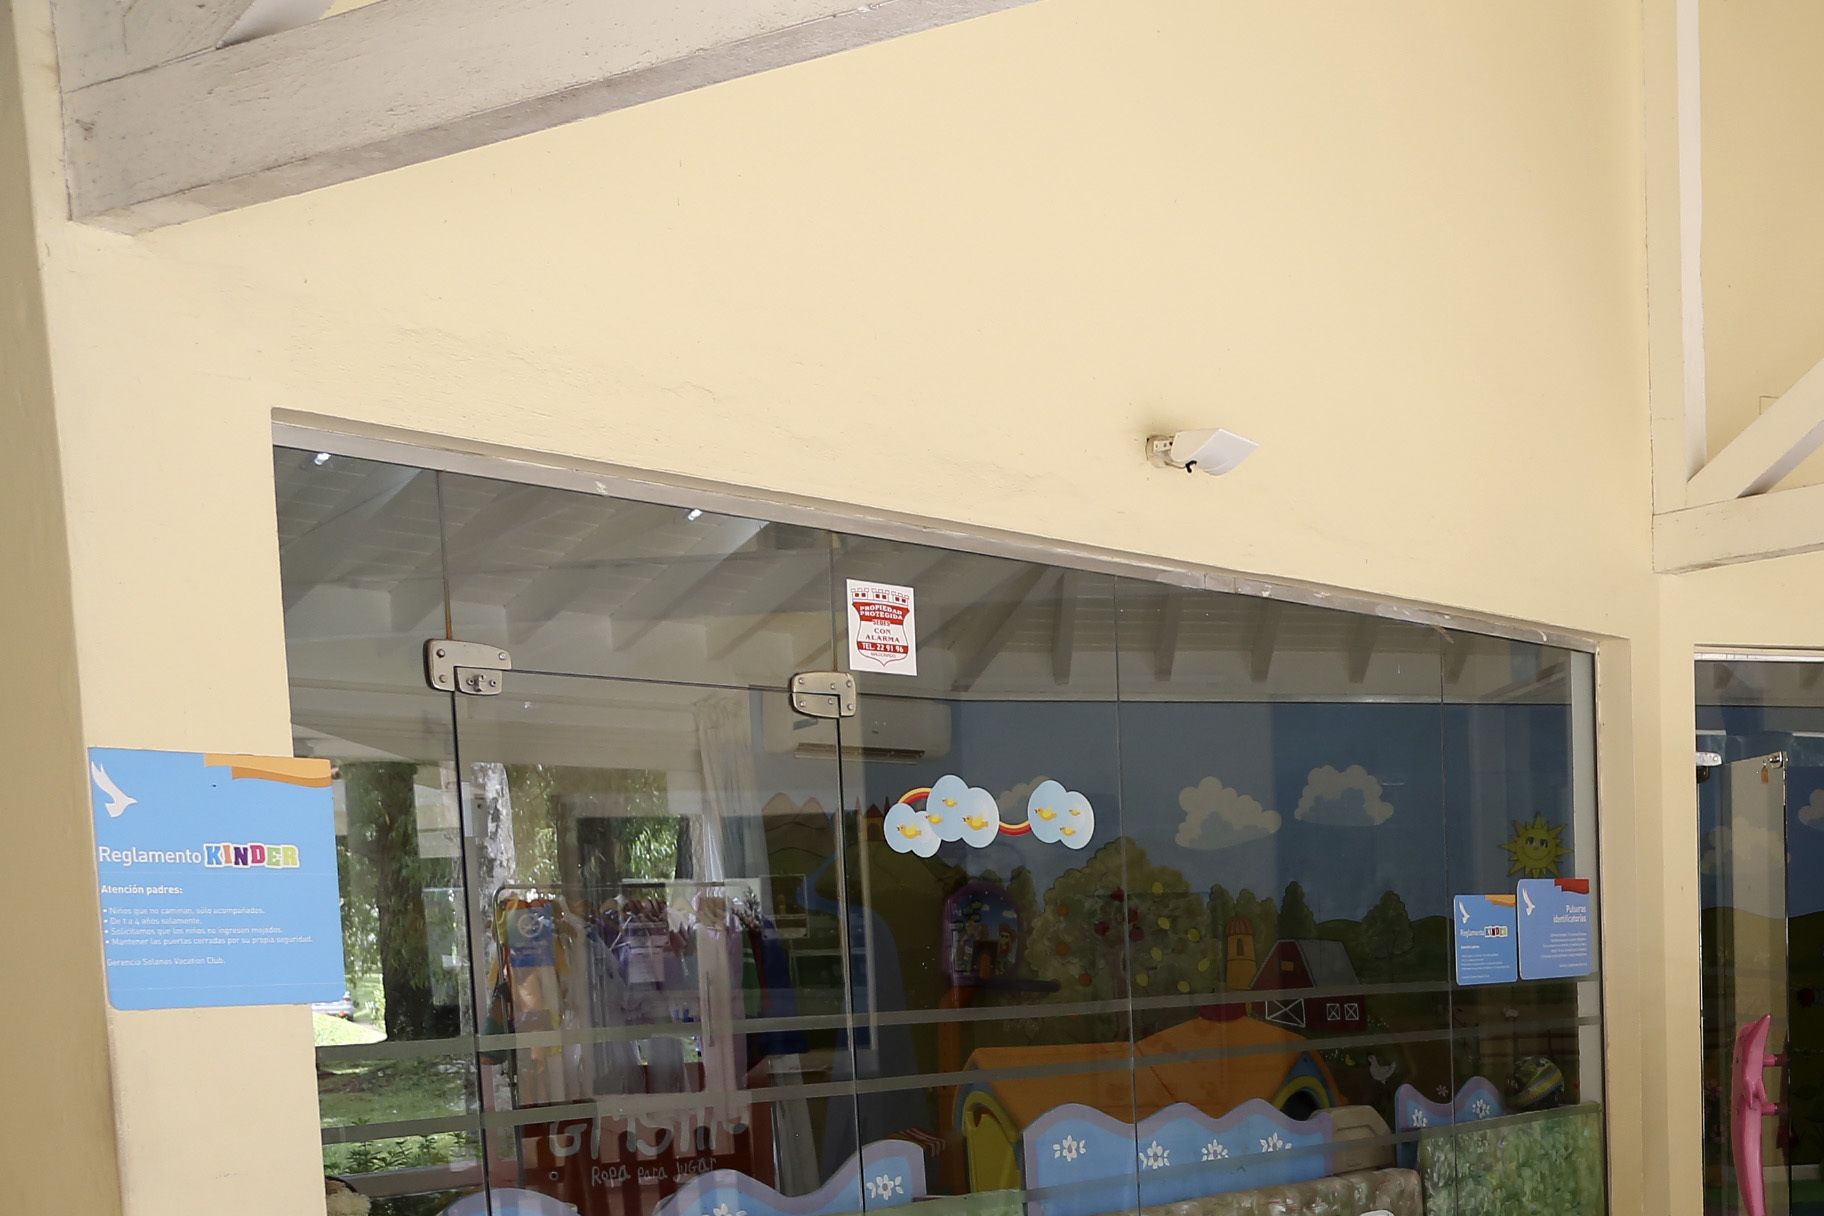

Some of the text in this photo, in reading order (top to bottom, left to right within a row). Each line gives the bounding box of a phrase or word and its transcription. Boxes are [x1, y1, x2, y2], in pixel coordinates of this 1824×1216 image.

[860, 605, 902, 615] PROPIEDAD
[860, 611, 903, 620] PROTEGIDA
[865, 634, 900, 643] ALARMA
[98, 842, 300, 868] Reglamento KINDER
[101, 885, 183, 896] Atención padres:
